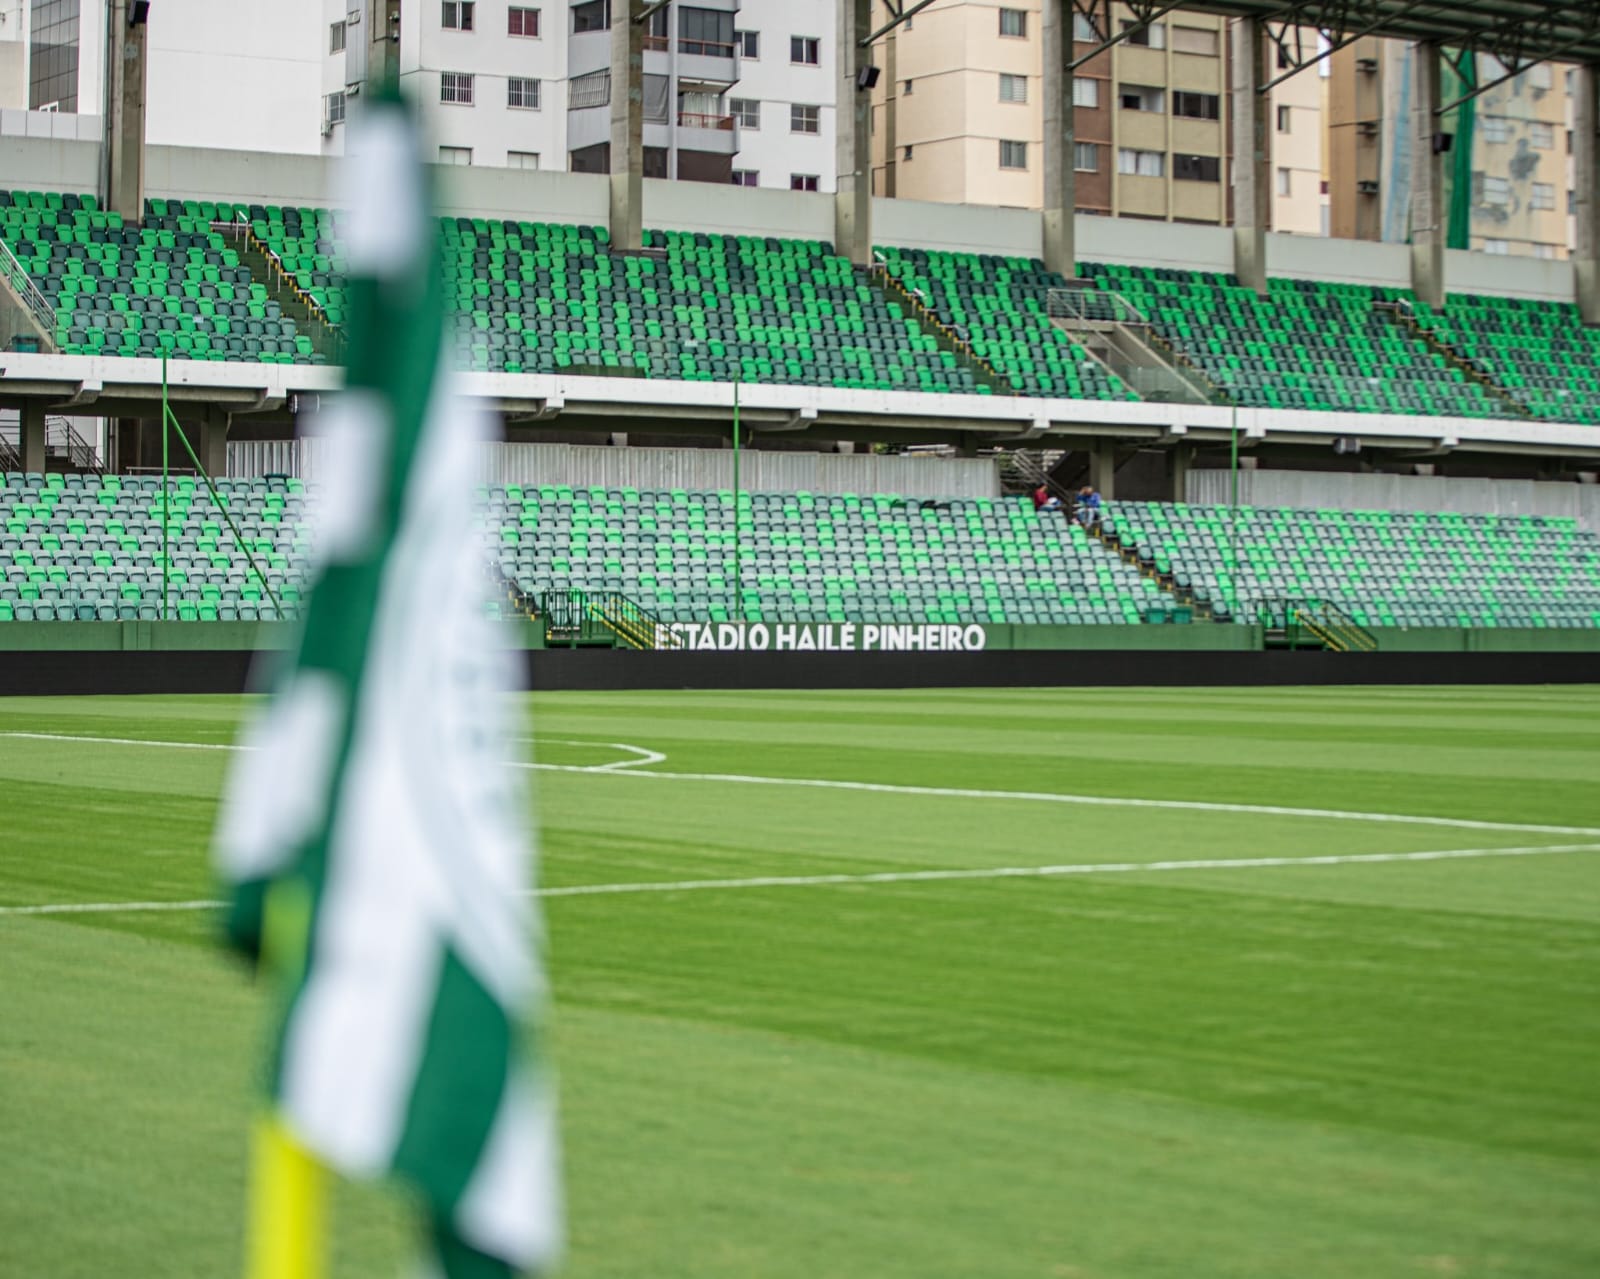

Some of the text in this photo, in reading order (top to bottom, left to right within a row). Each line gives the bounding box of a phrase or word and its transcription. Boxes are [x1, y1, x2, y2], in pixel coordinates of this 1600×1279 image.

[654, 621, 986, 651] ESTÁDIO HAILÉ PINHEIRO
